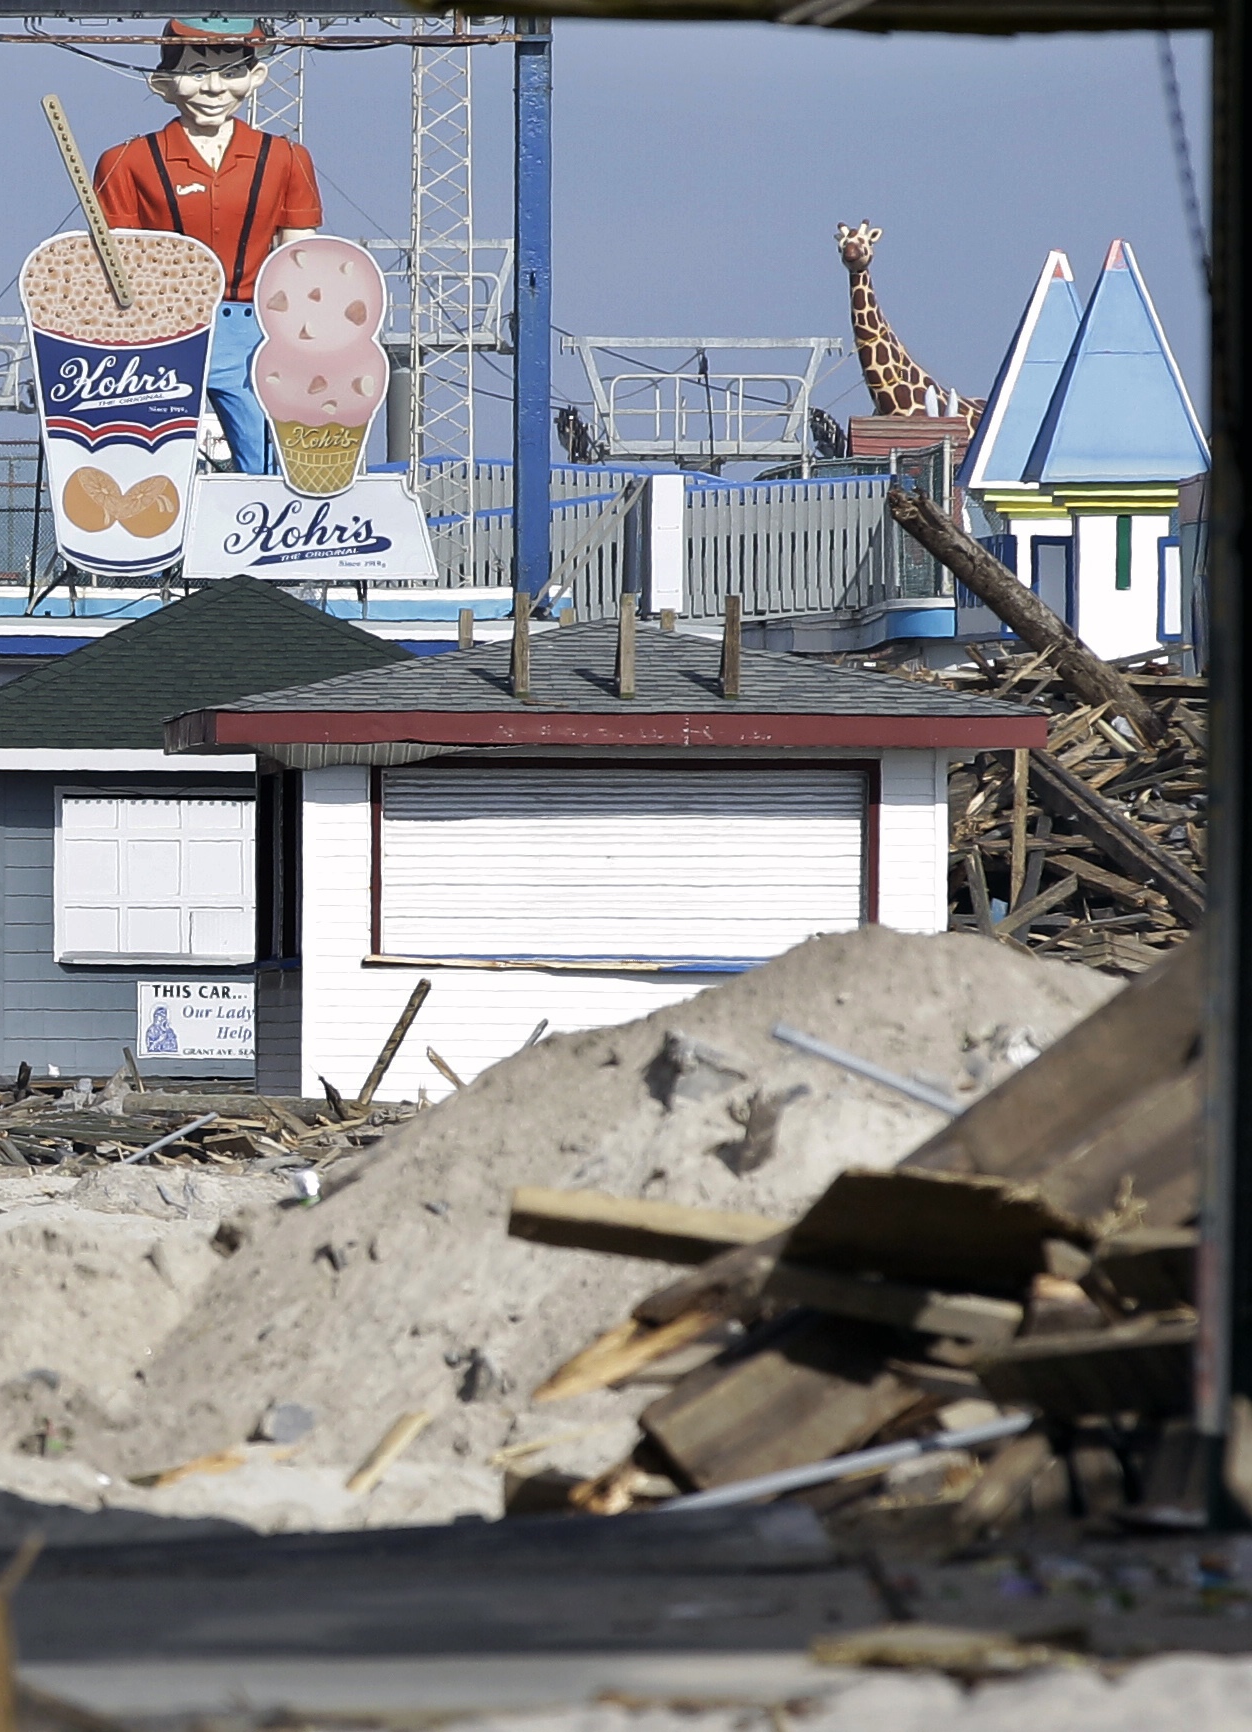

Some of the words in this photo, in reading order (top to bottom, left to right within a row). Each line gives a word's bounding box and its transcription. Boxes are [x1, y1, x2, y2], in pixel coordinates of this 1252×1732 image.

[50, 355, 180, 402] Kohr's
[286, 426, 360, 448] Kohr's
[223, 500, 374, 554] Kohr's
[279, 552, 301, 562] THE
[305, 547, 359, 559] ORIGINAL
[152, 984, 191, 998] THIS
[182, 1004, 212, 1018] Our
[216, 1006, 255, 1022] Lady
[216, 1026, 253, 1043] Help
[182, 1047, 213, 1056] GRANT
